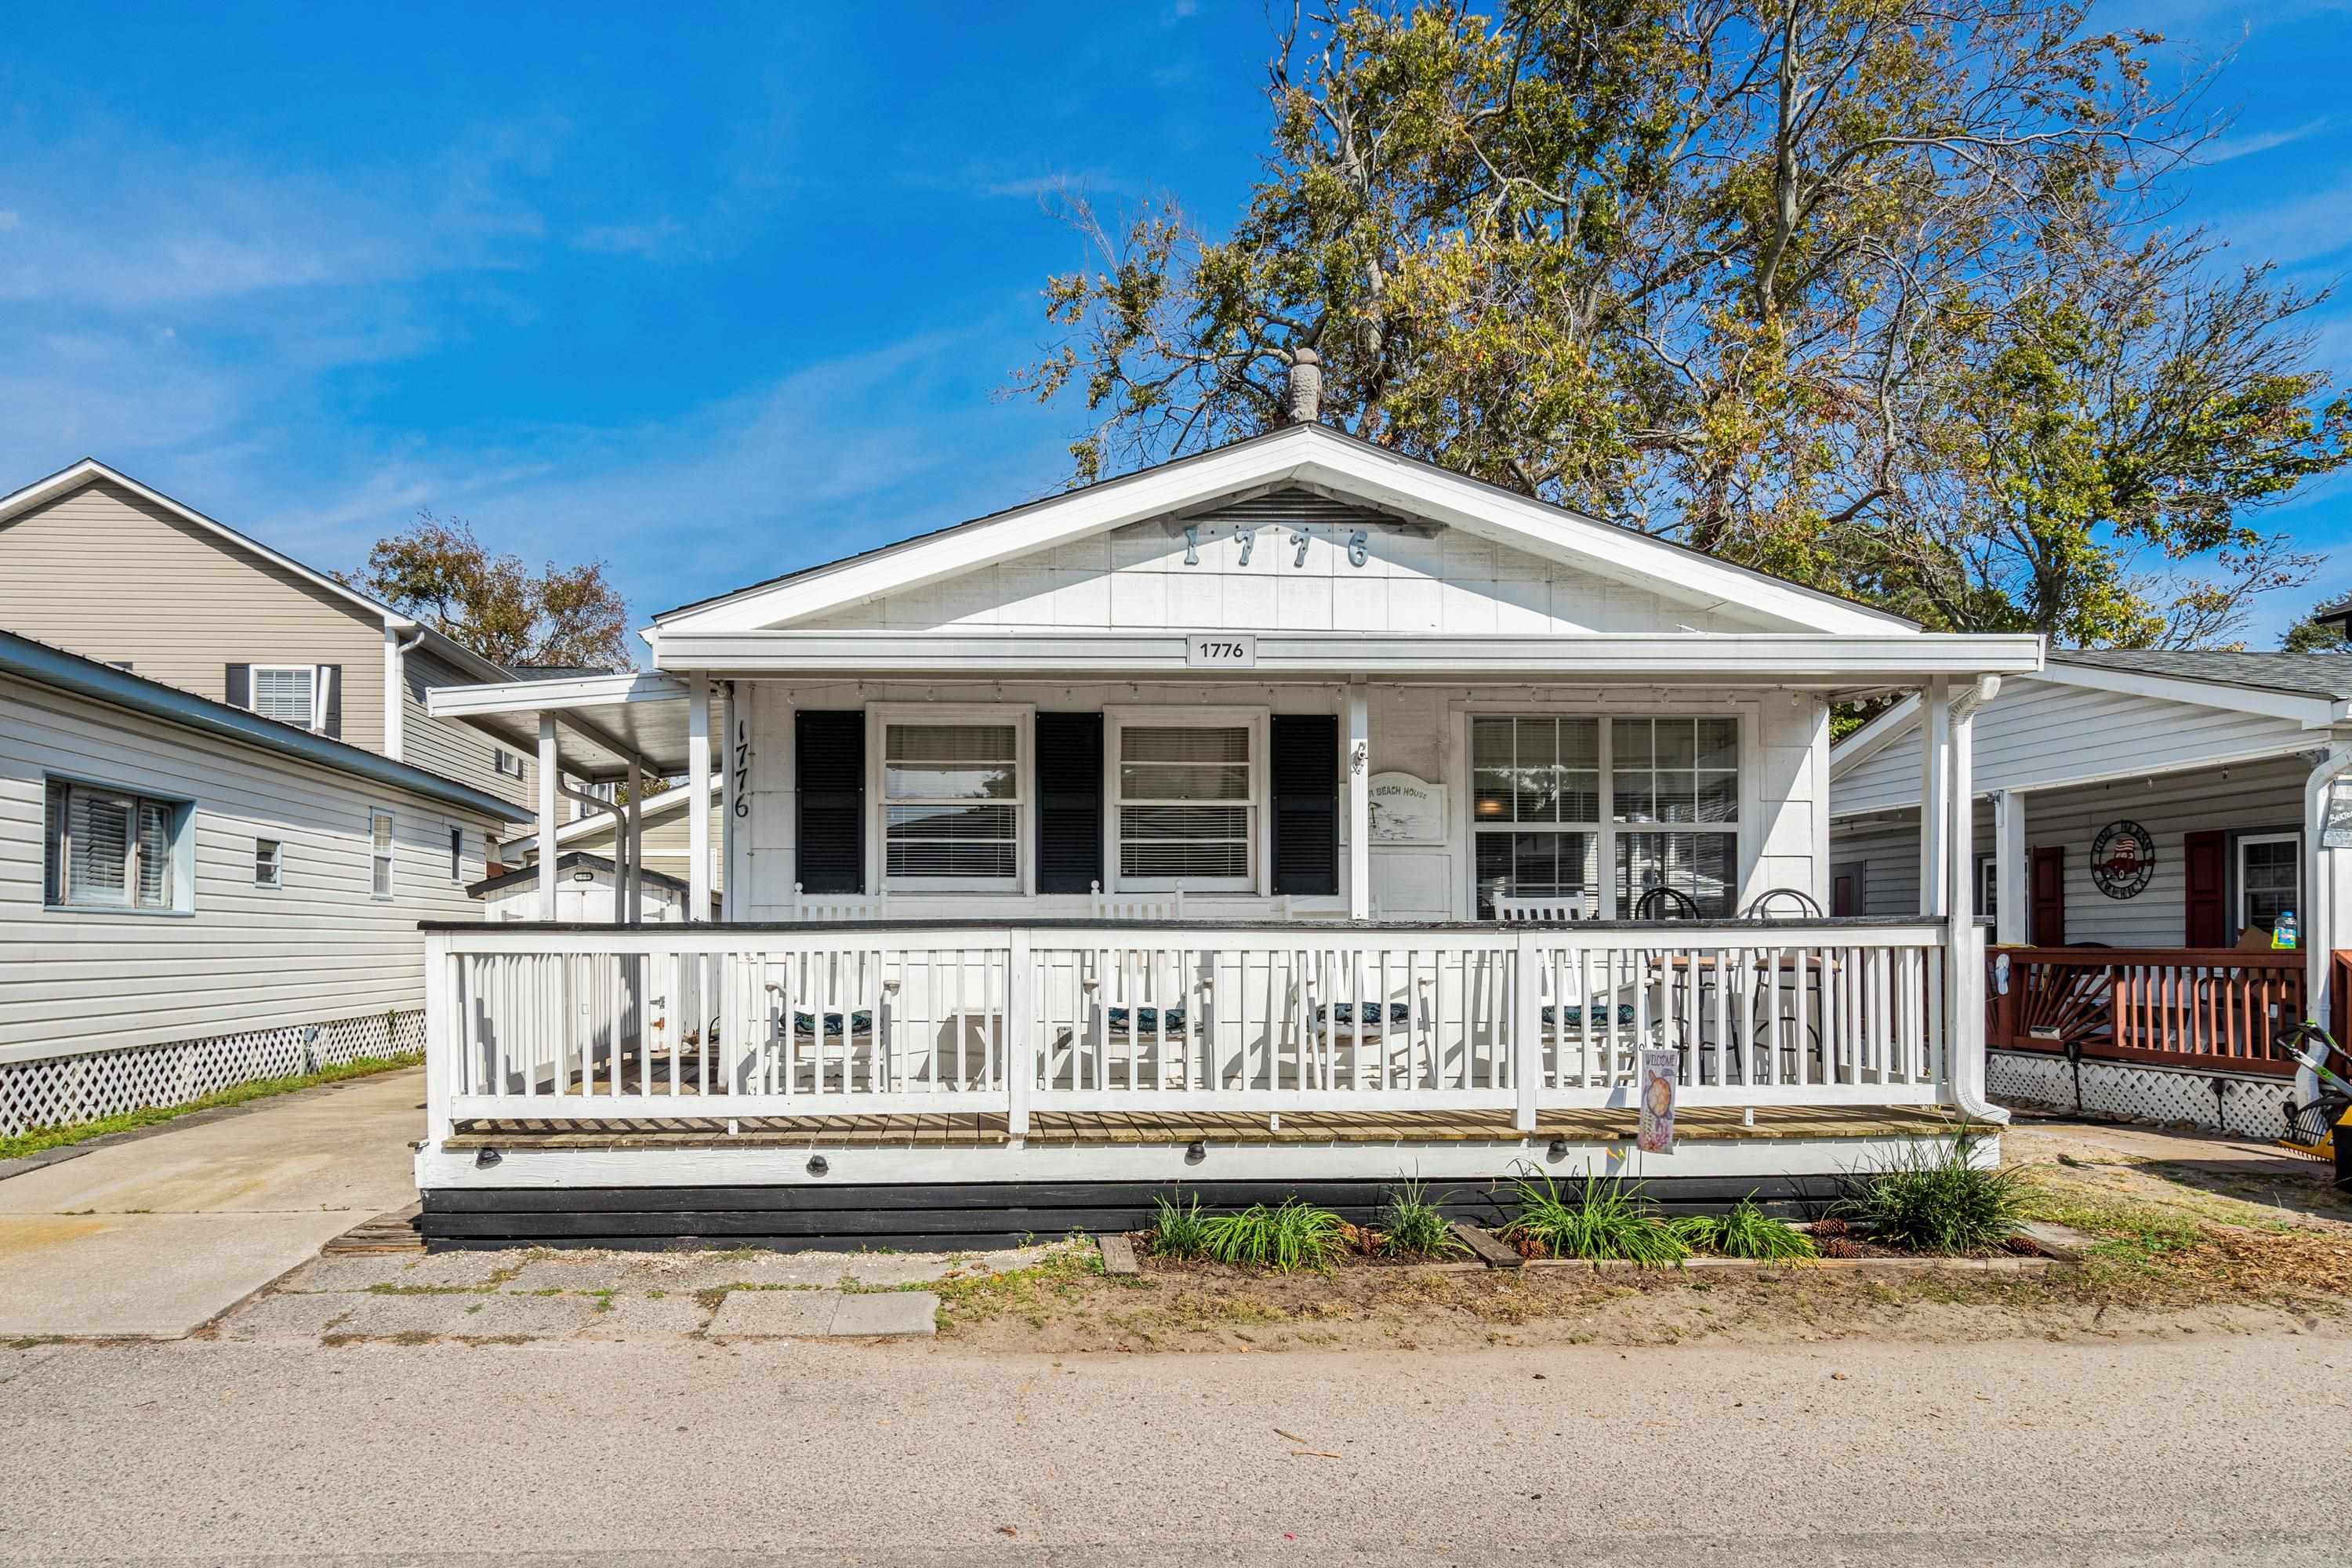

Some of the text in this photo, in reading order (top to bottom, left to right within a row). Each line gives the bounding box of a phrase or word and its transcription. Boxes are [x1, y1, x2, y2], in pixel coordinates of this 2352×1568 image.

[1184, 526, 1369, 568] 1776
[1200, 643, 1243, 658] 1776
[735, 720, 749, 818] 1776
[1376, 786, 1401, 797] BEACH
[1403, 786, 1428, 800] HOUSE
[2098, 878, 2146, 898] AMERICA
[1645, 1054, 1675, 1067] WELCOME
